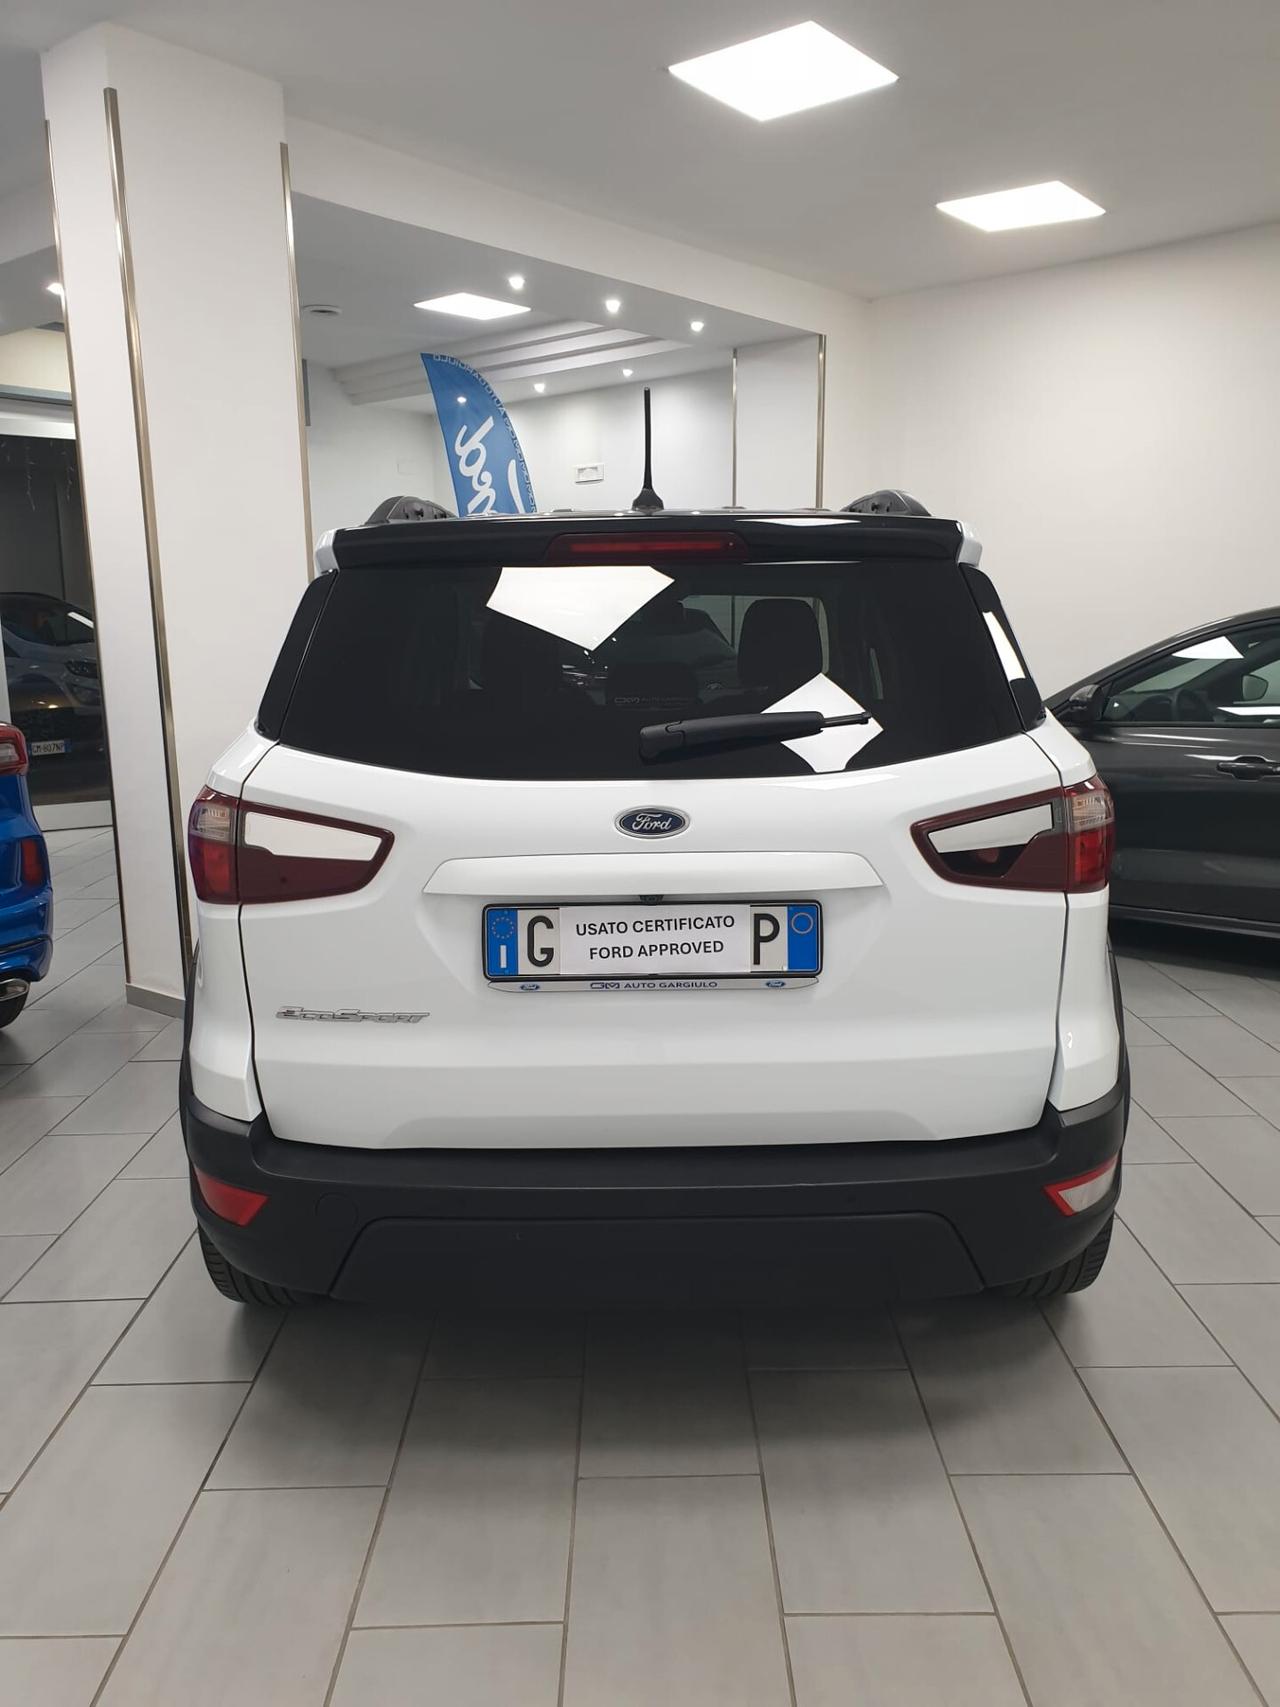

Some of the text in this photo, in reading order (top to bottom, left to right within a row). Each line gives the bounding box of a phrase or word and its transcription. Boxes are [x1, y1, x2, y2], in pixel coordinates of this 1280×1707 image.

[632, 813, 672, 830] Ford
[576, 915, 736, 937] USATO CERTIFICATO
[527, 915, 555, 967] G
[589, 940, 725, 961] FORD APPROVED
[753, 913, 780, 965] P
[500, 945, 507, 969] I
